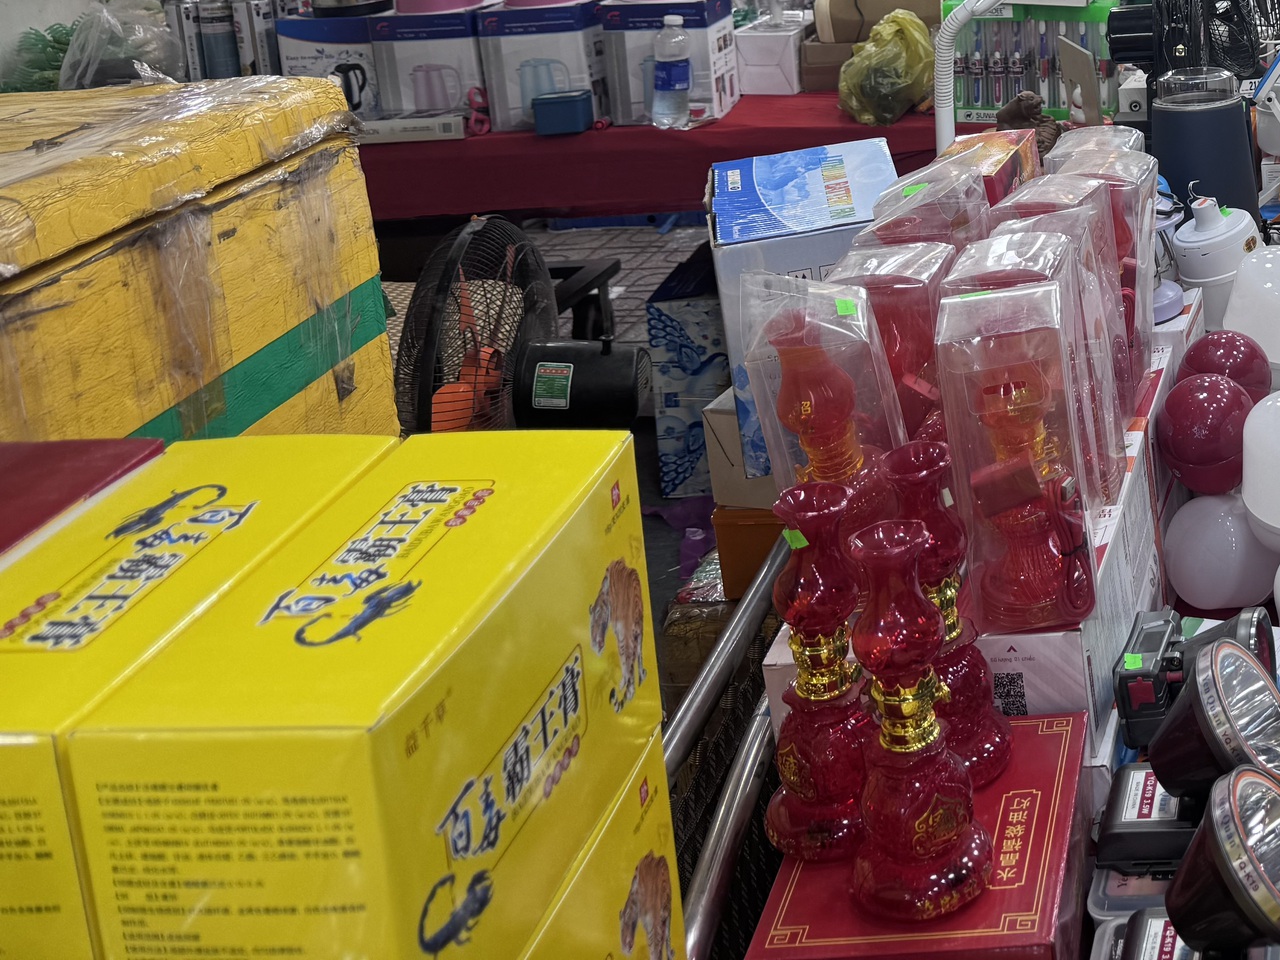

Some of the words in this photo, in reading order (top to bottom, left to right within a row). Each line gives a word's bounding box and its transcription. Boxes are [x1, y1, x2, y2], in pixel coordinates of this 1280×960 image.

[1206, 695, 1223, 727] Quan
[1221, 729, 1244, 764] YQ-K19
[1141, 798, 1151, 815] 3.5W
[996, 797, 1032, 881] 水晶福袋油灯
[1220, 811, 1238, 849] Quan
[1234, 852, 1260, 893] YQ-K19
